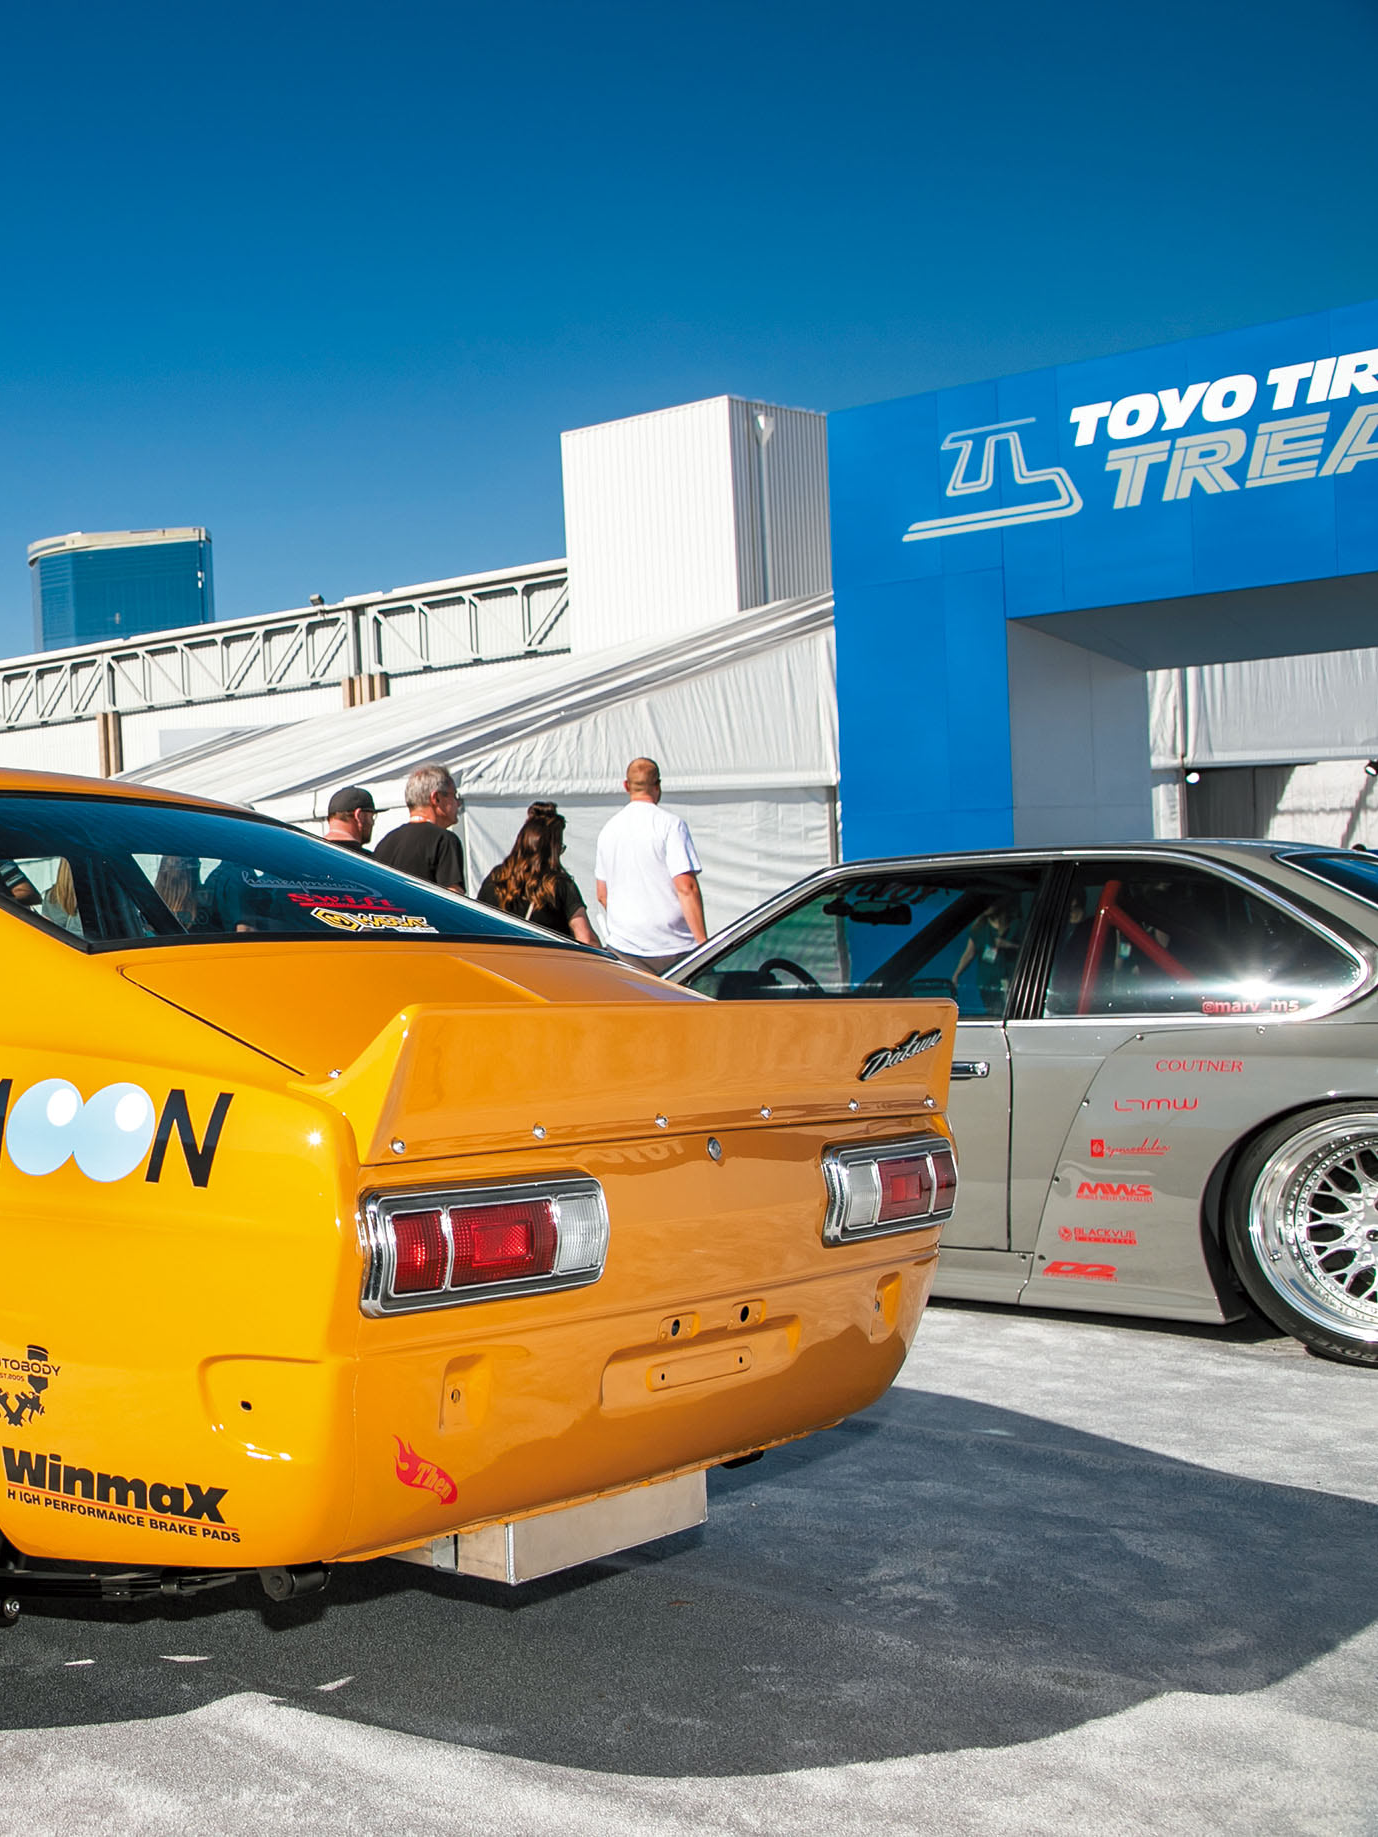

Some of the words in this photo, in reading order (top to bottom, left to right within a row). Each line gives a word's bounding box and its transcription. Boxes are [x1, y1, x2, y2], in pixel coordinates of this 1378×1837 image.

[1069, 374, 1258, 447] TOYO
[1267, 348, 1378, 412] TIR
[1156, 1058, 1243, 1073] COUTNER
[1074, 1227, 1136, 1239] BLACKVUE
[7, 1489, 41, 1505] HIGH
[44, 1498, 145, 1527] PERFORMANCE
[149, 1519, 198, 1537] BRAKE
[202, 1527, 241, 1543] PADS
